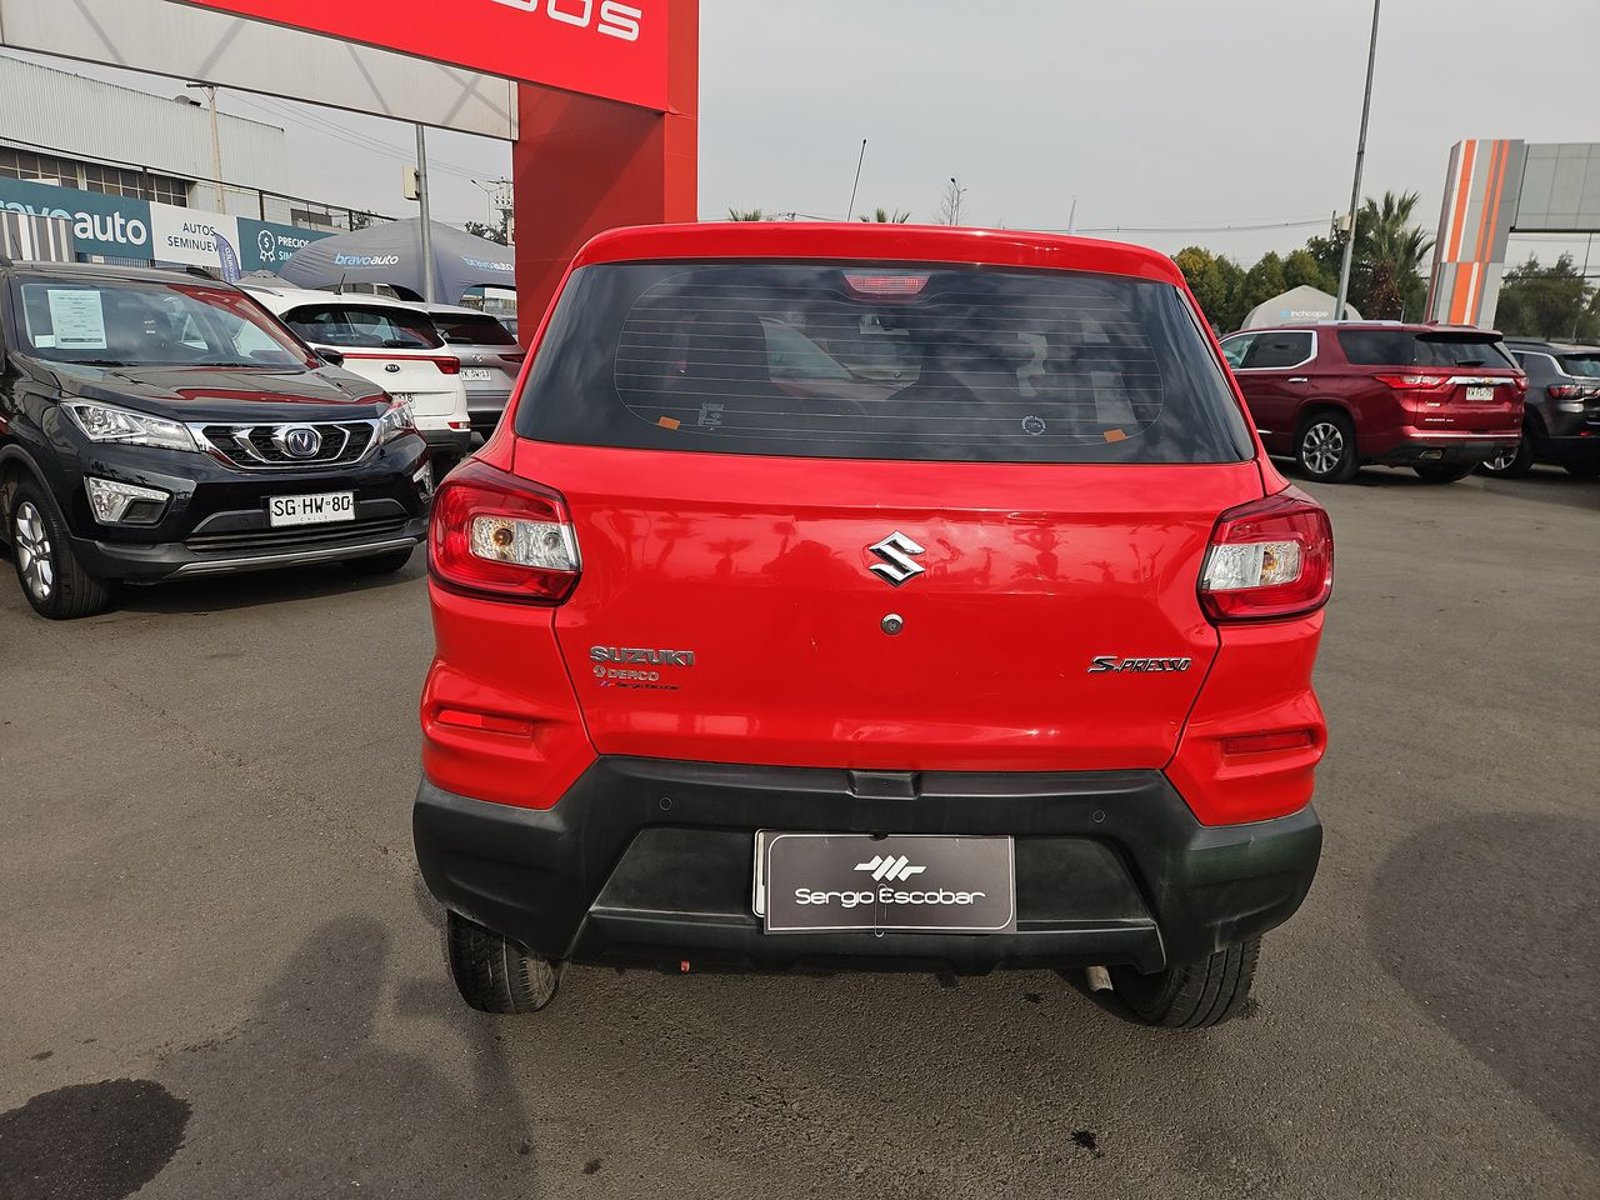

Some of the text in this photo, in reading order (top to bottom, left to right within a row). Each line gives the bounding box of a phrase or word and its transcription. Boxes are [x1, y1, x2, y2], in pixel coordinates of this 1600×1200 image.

[183, 222, 215, 237] AUTOS
[335, 253, 399, 266] bravoauto
[590, 645, 694, 666] SUZUKI
[795, 888, 986, 908] Sergio Escobar
